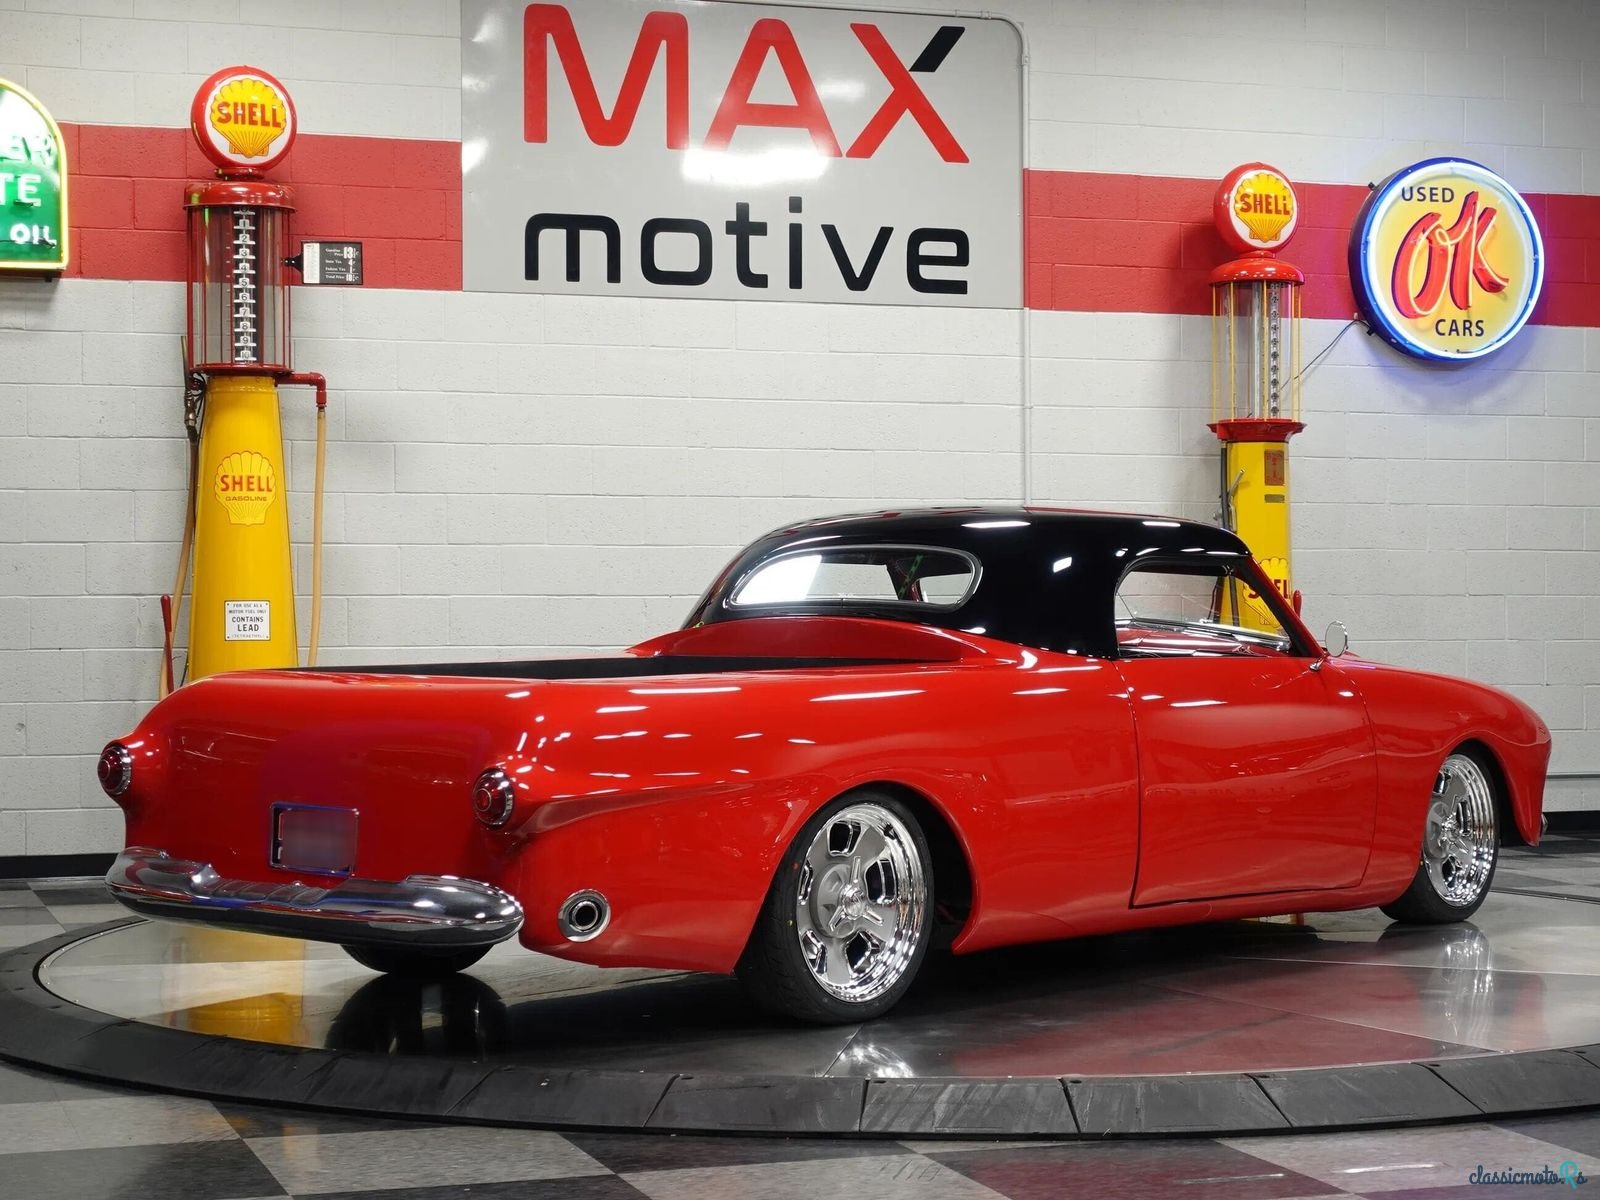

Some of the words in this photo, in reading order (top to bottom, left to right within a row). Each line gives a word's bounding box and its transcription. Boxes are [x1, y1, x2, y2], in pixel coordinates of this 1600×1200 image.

[523, 3, 970, 164] MAX
[217, 101, 282, 128] SHELL
[1239, 193, 1290, 216] SHELL
[1401, 186, 1455, 203] USED
[10, 223, 57, 246] OIL
[524, 196, 970, 295] motive
[1391, 190, 1510, 319] OK
[1435, 319, 1485, 337] CARS
[220, 474, 273, 492] SHELL
[237, 624, 260, 632] LEAD
